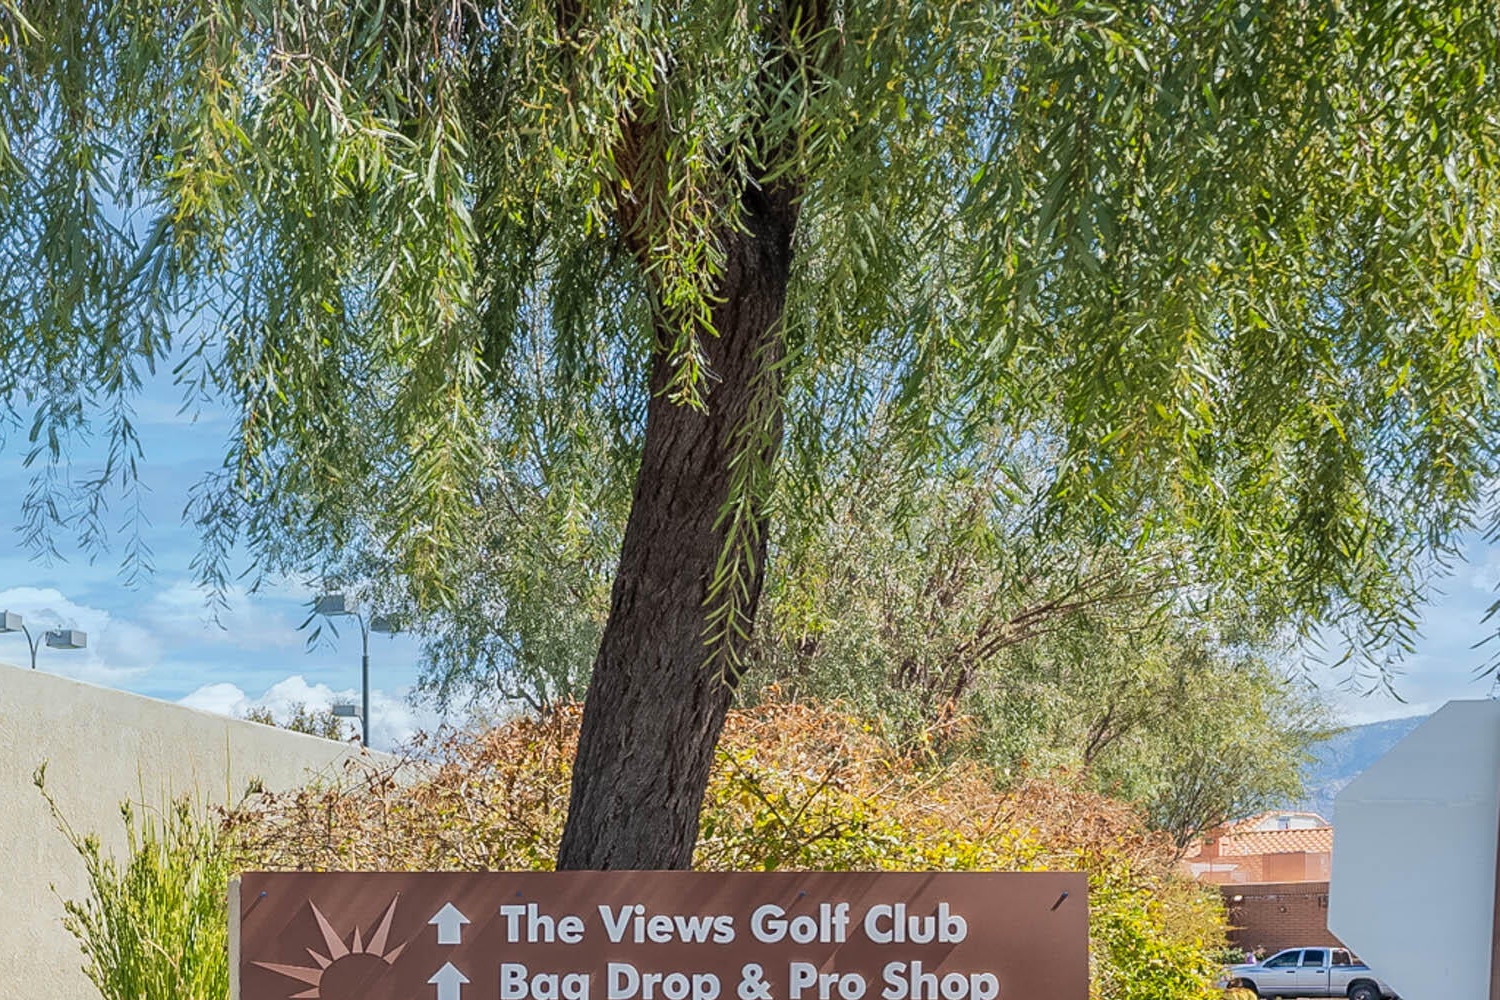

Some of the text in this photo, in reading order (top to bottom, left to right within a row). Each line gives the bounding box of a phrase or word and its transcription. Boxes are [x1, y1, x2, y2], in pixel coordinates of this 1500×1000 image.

[500, 902, 967, 943] The Views Golf Club
[738, 964, 773, 1000] &
[790, 962, 866, 1000] Pro
